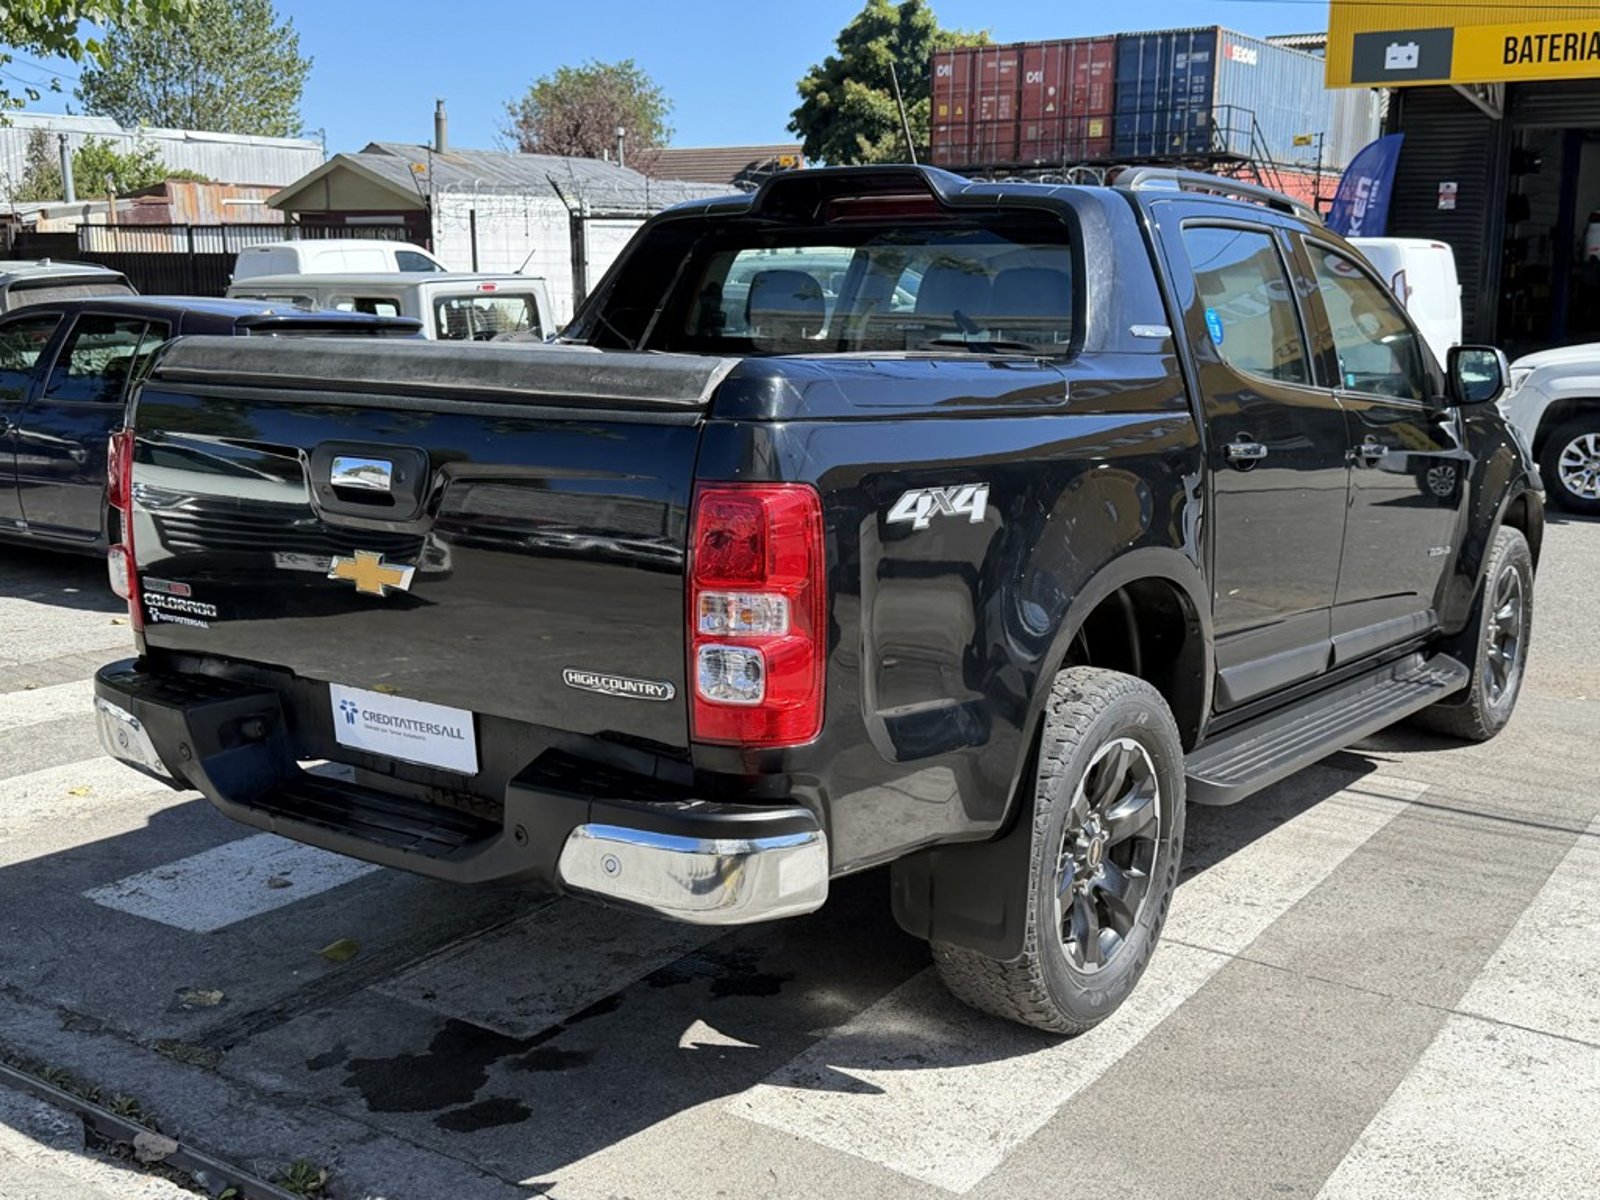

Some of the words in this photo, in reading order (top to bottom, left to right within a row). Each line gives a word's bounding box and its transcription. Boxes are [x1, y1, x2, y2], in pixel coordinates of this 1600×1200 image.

[1503, 31, 1600, 65] BATERIA
[143, 593, 217, 617] COLORADO
[568, 672, 599, 685] HIGH
[601, 677, 665, 697] COUNTRY
[362, 709, 465, 740] CREDITATTERSALL
